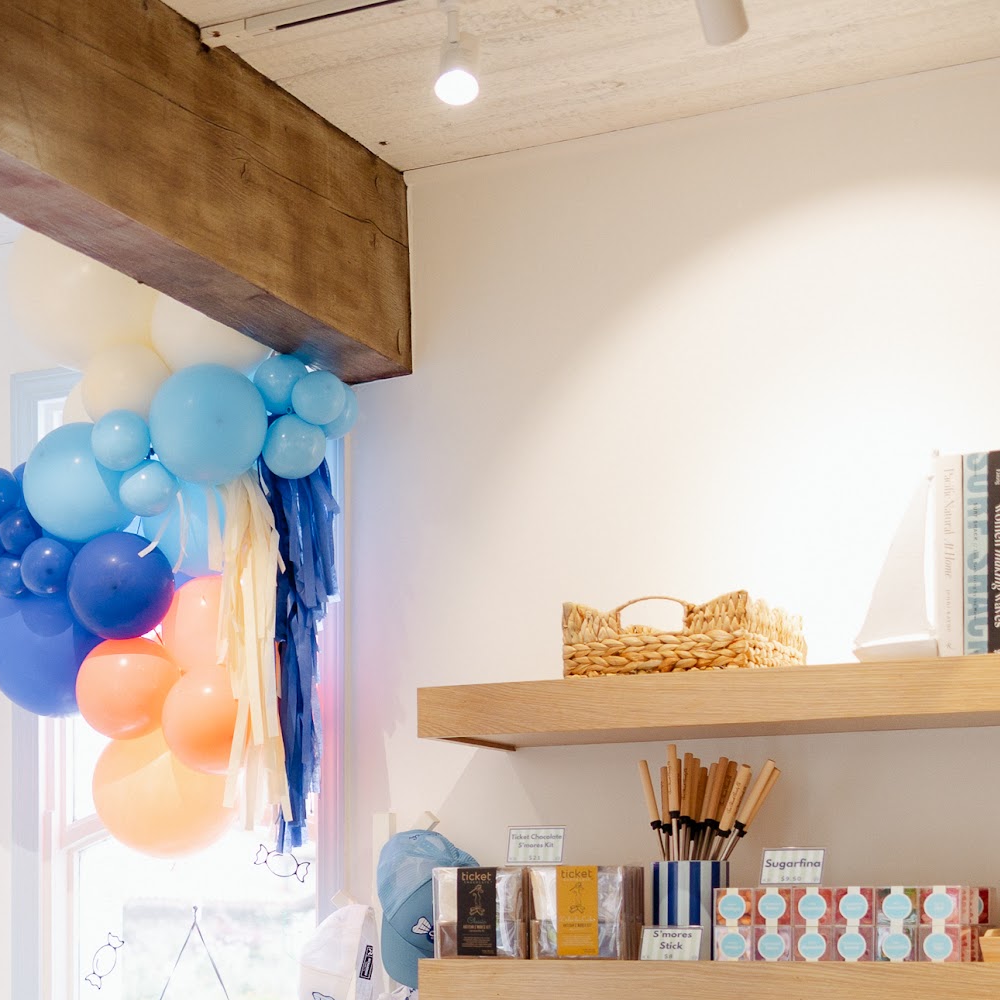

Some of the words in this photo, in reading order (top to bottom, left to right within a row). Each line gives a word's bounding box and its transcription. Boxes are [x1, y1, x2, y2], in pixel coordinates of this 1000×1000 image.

[765, 858, 821, 871] Sugarfina
[461, 872, 492, 881] ticket
[561, 869, 593, 879] ticket
[653, 930, 693, 939] S'mores
[659, 941, 683, 950] Stick
